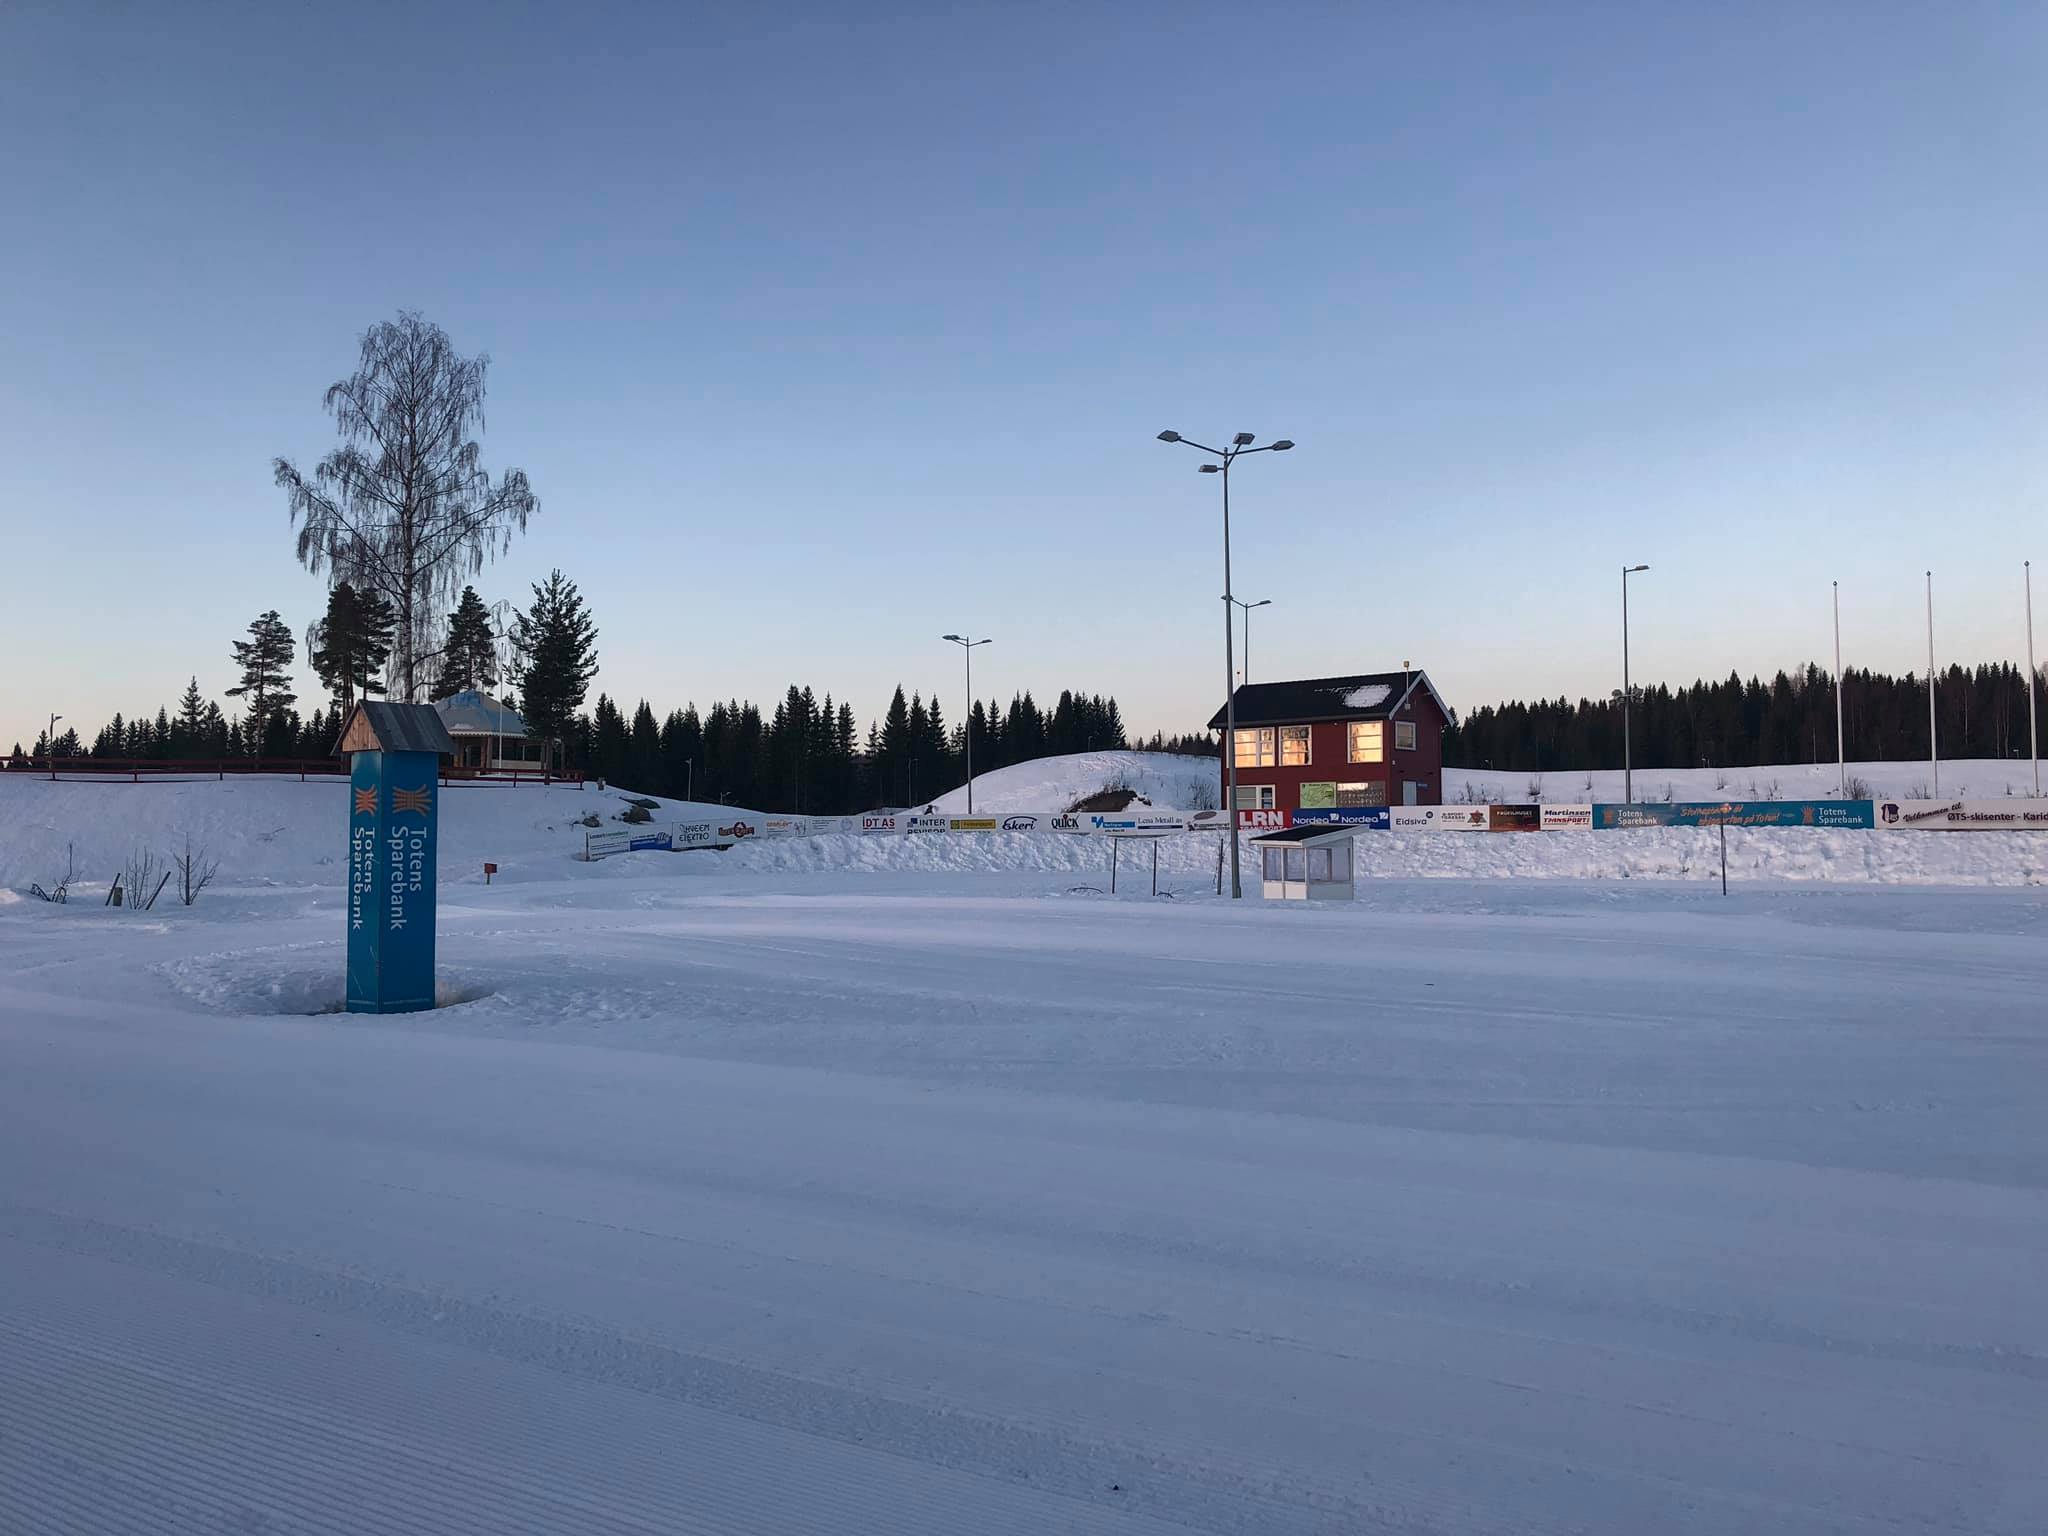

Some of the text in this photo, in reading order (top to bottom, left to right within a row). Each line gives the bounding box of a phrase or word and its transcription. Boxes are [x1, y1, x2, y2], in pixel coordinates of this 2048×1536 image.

[1618, 809, 1643, 817] Totens
[1819, 807, 1847, 815] Totens
[1903, 802, 1962, 822] Velkommen til
[1239, 811, 1284, 826] LRN
[1292, 816, 1330, 824] Nordea
[1341, 814, 1379, 823] Nordea
[1819, 815, 1863, 825] Sparebank
[1948, 812, 2015, 821] ØTS-skisenter
[882, 818, 895, 827] AS
[919, 818, 946, 827] INTER
[1051, 814, 1079, 829] QUICK
[1617, 817, 1658, 826] Sparebank
[364, 827, 376, 893] Totens
[410, 827, 427, 892] Totens
[352, 827, 365, 930] Sparebank
[388, 826, 408, 930] Sparebank
